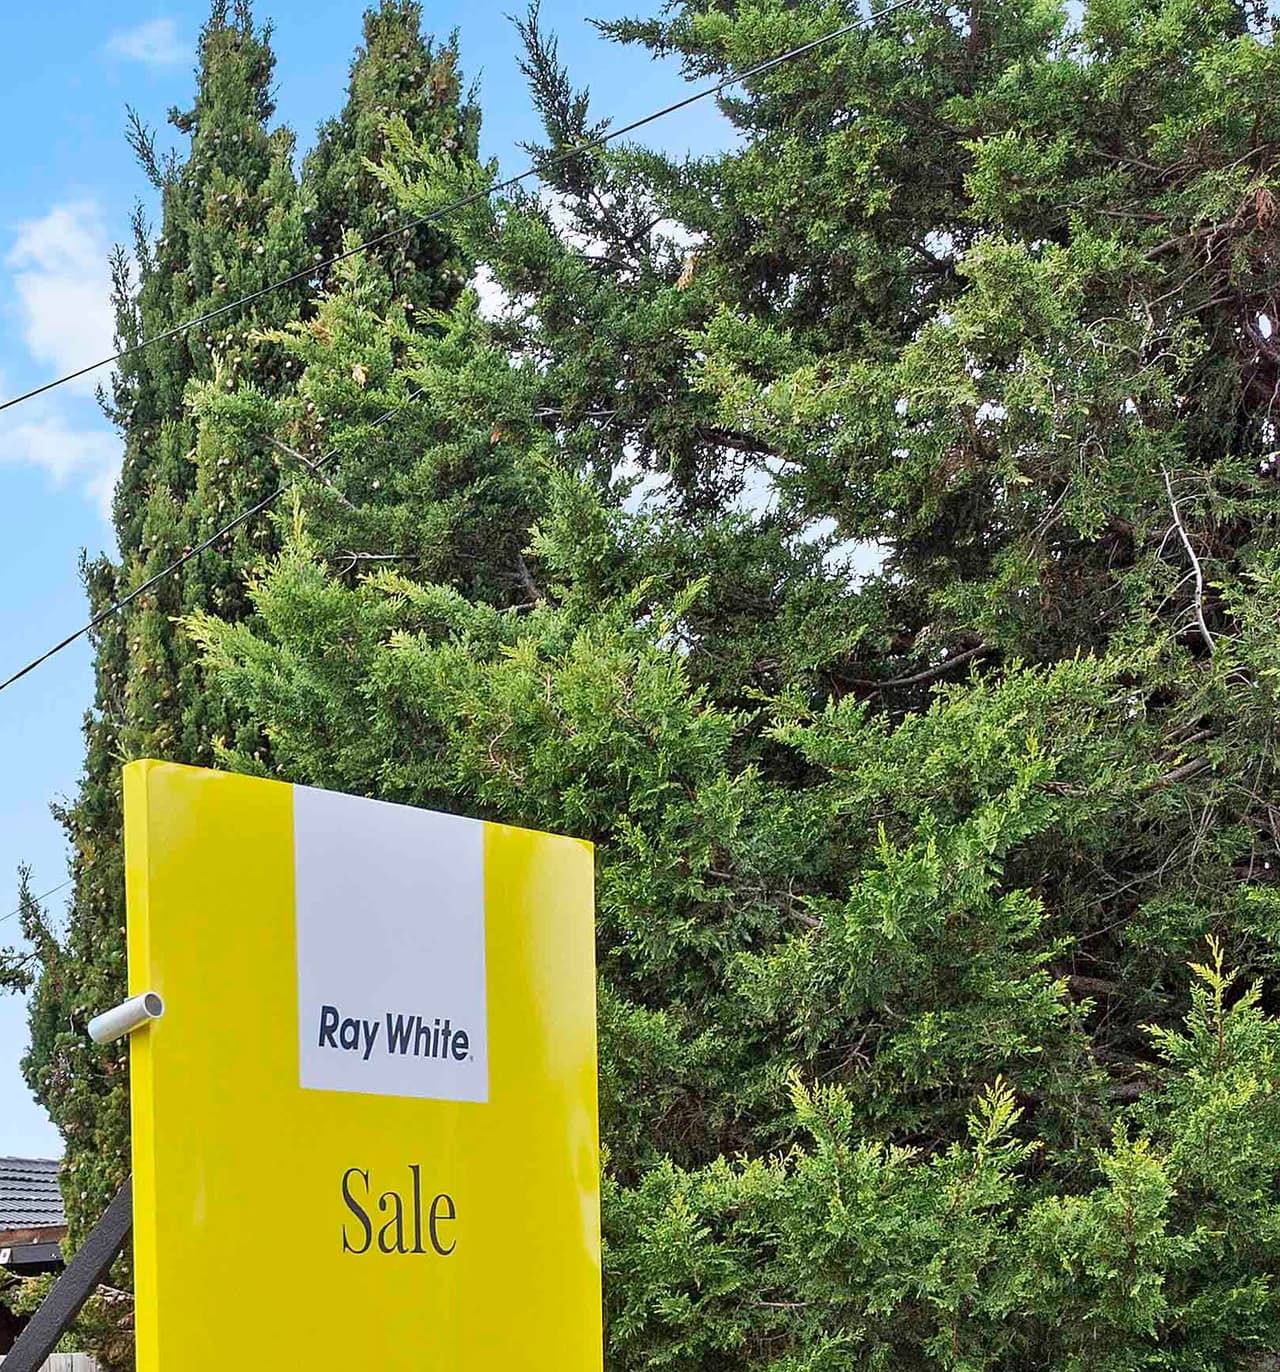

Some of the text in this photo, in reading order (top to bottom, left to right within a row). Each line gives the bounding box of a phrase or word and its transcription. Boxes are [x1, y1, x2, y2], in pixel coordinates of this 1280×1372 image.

[318, 1005, 470, 1061] Ray White
[341, 1164, 457, 1256] Sale
